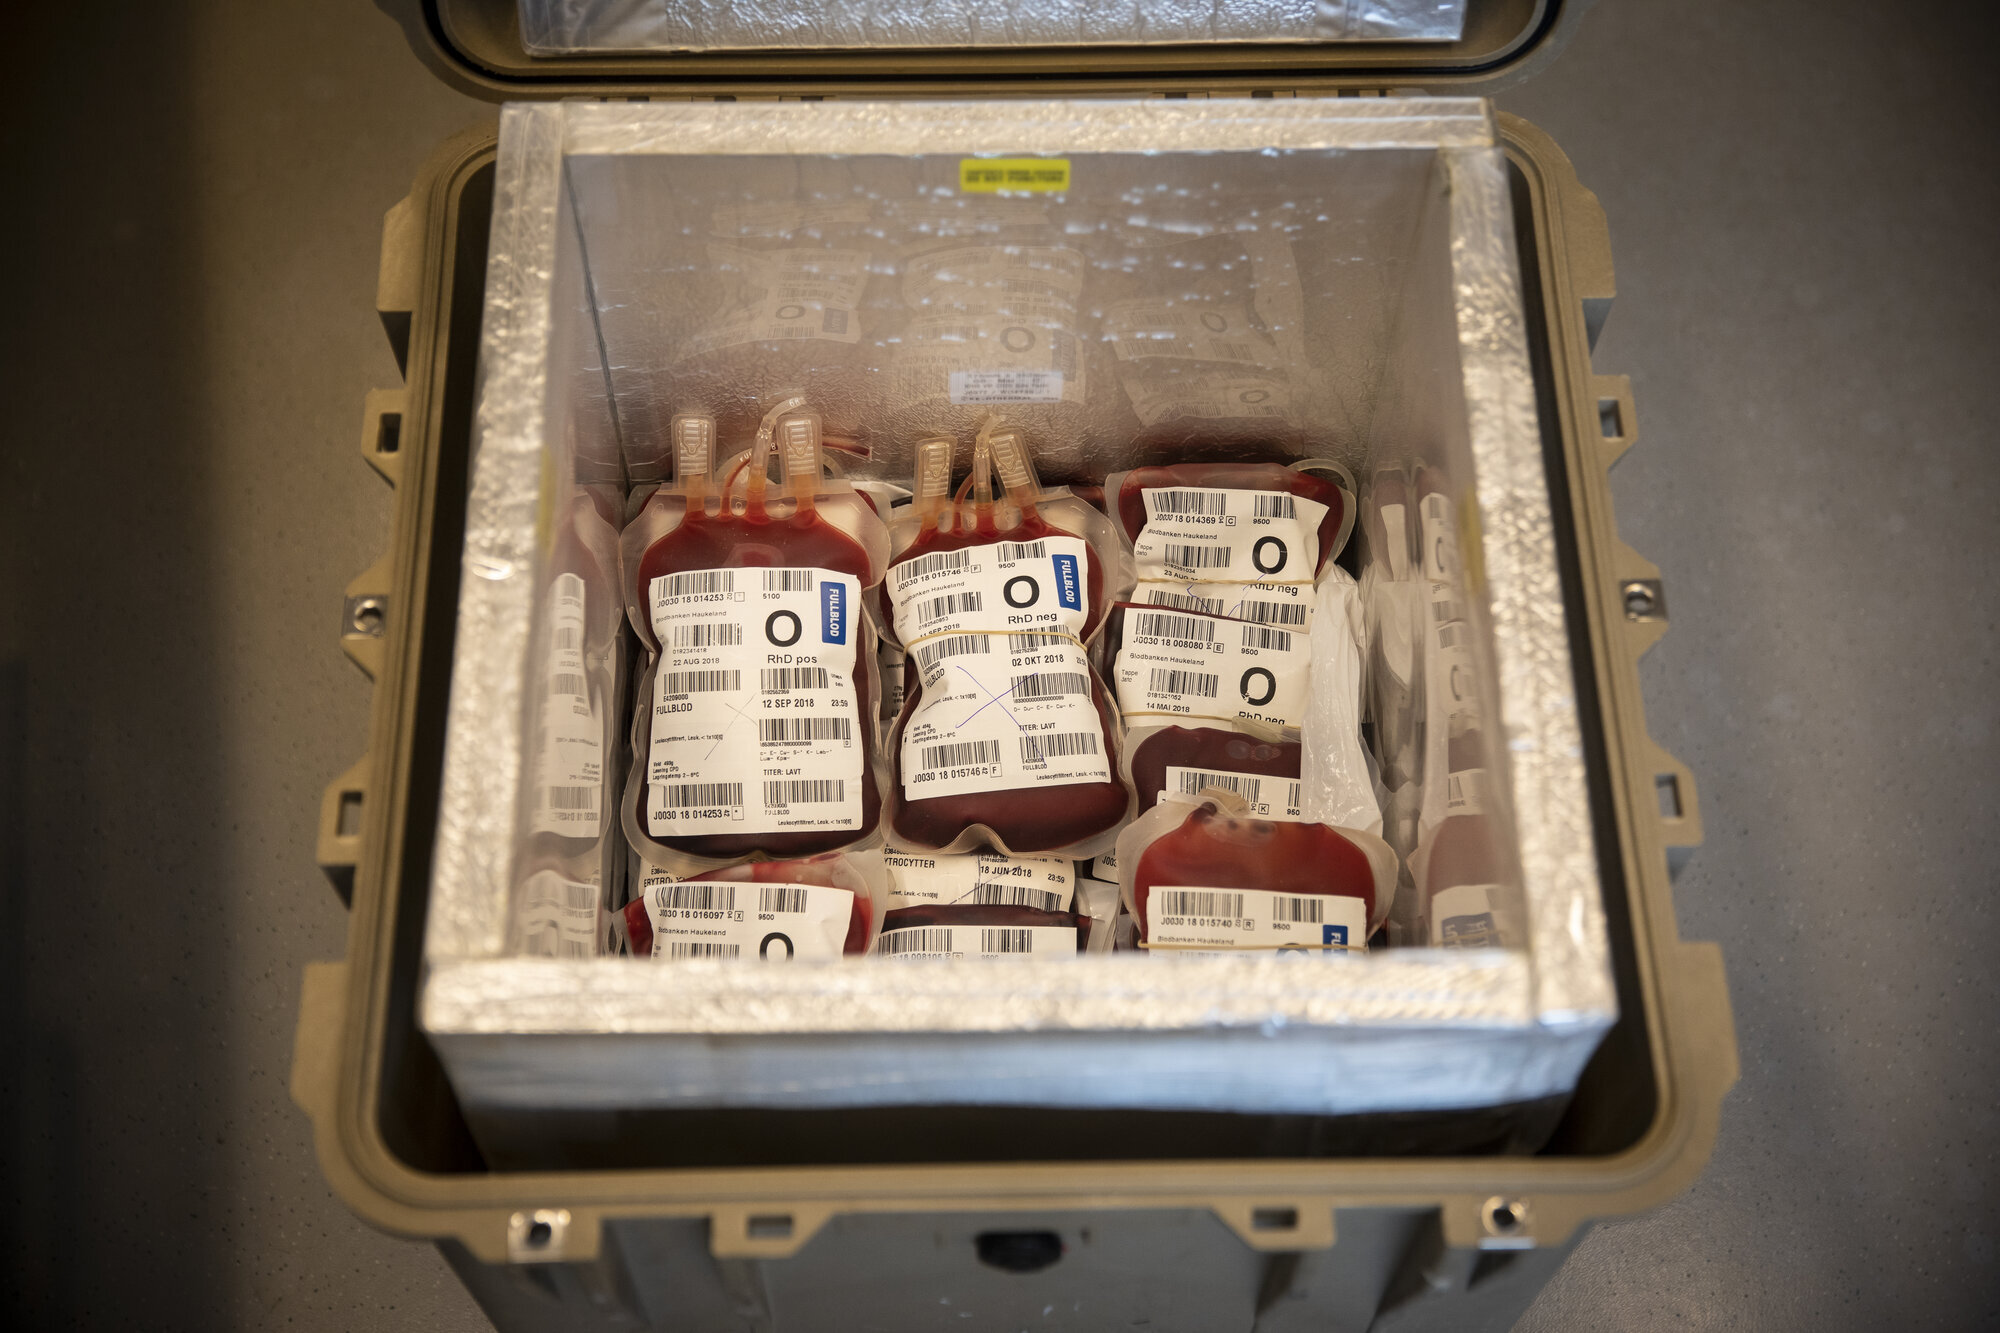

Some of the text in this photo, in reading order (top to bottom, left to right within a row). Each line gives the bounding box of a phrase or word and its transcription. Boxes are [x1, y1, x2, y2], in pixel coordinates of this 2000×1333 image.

[1186, 516, 1216, 524] 014369
[1183, 532, 1217, 540] Haukeland
[1252, 536, 1288, 574] O
[898, 579, 918, 592] J0030
[932, 569, 961, 580] 015746
[931, 581, 965, 592] Haukeland
[1061, 560, 1075, 603] FULLBLOD
[1003, 575, 1040, 608] O
[1277, 585, 1298, 596] neg
[657, 597, 679, 608] J0030
[694, 594, 724, 602] 014253
[829, 588, 840, 637] FULLBLOD
[1008, 613, 1057, 624] RhD neg
[765, 610, 802, 647] O
[944, 623, 960, 631] 2018
[1133, 636, 1158, 645] J0030
[1161, 638, 1171, 646] 18
[1173, 639, 1204, 650] 008080
[767, 654, 817, 665] RhD pos
[1012, 654, 1064, 666] 02 OKT 2018
[1130, 653, 1205, 666] Blodbanken Haukeland
[1240, 667, 1276, 706] O
[656, 703, 693, 715] FULLBLOD
[762, 699, 814, 708] 12 SEP 2018
[913, 772, 935, 783] J0030
[939, 770, 948, 780] 18
[951, 767, 980, 779] 015746
[653, 810, 676, 820] J0030
[680, 811, 690, 819] 18
[693, 809, 722, 819] 014253
[1012, 868, 1032, 877] 2018
[1048, 874, 1065, 883] 23:59
[693, 910, 724, 919] 016097
[1160, 917, 1184, 925] J0030
[1188, 918, 1197, 926] 18
[1200, 919, 1232, 928] 015740
[760, 932, 794, 961] O
